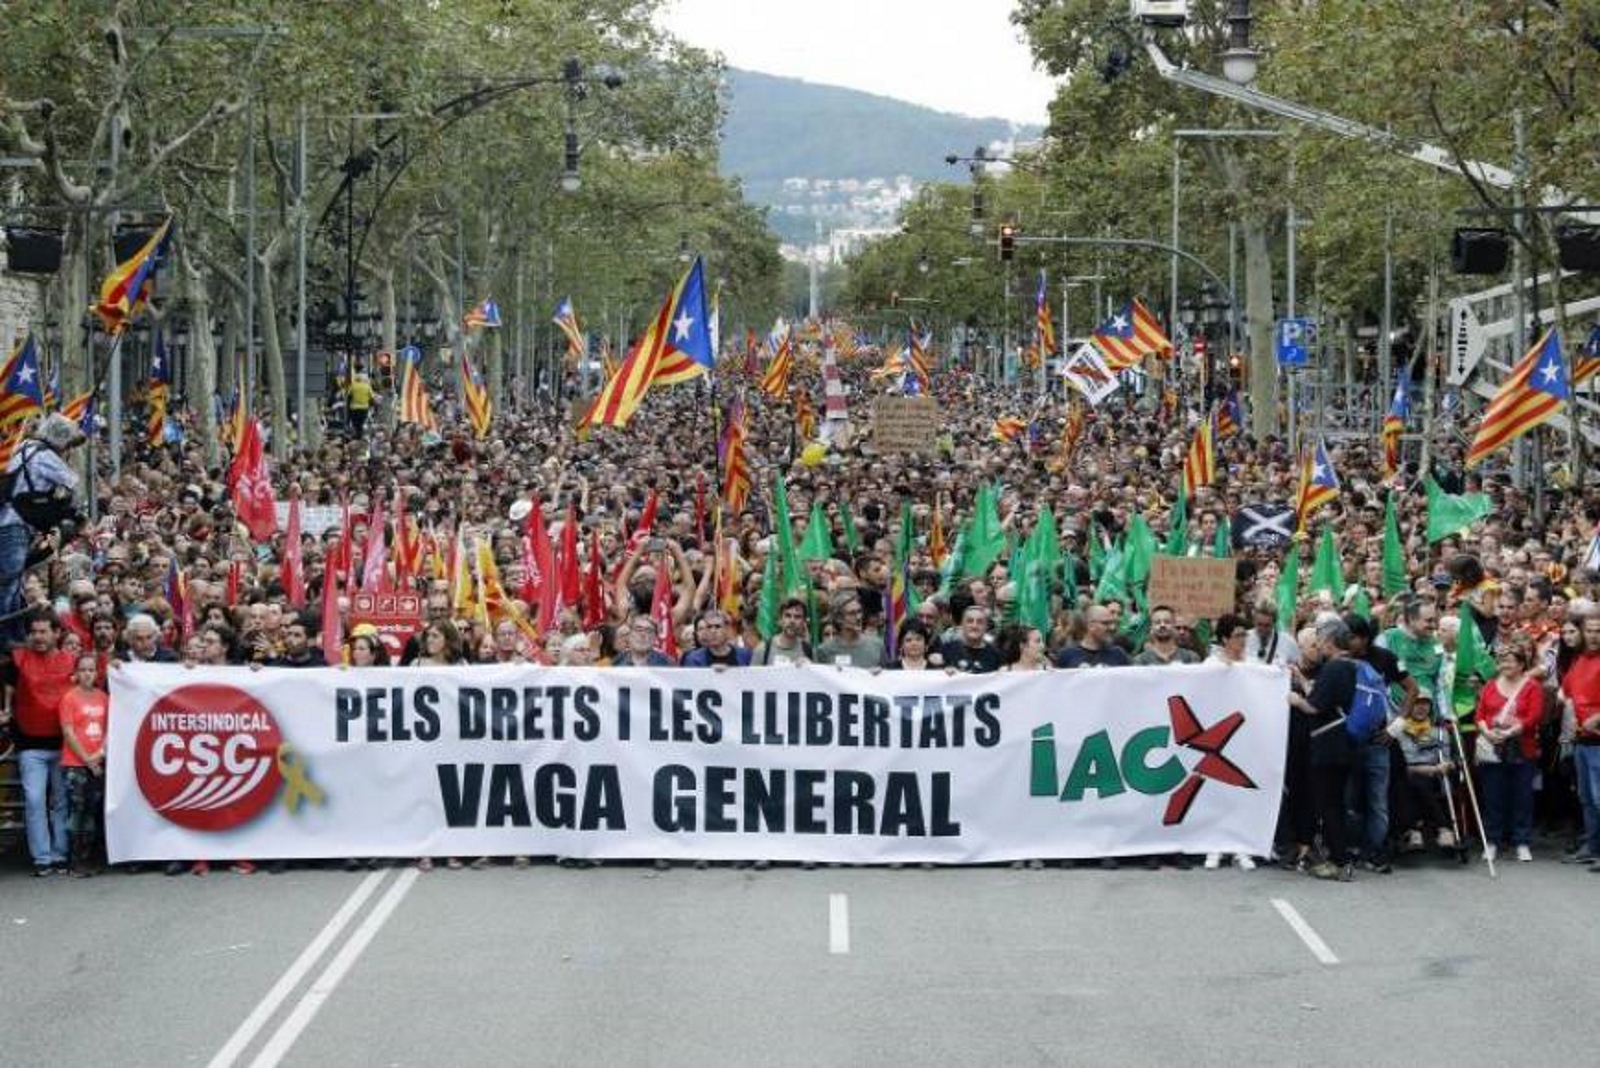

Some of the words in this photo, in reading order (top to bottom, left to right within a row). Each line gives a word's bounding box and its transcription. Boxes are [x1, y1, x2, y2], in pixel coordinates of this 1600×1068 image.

[150, 711, 271, 732] INTERSINDICAL
[335, 686, 441, 743] PELS
[457, 685, 601, 743] DRETS
[618, 686, 631, 741] I
[649, 687, 723, 745] LES
[741, 690, 1002, 749] LLIBERTATS
[150, 733, 258, 776] CSC
[437, 762, 627, 831] VAGA
[652, 764, 962, 838] GENERAL
